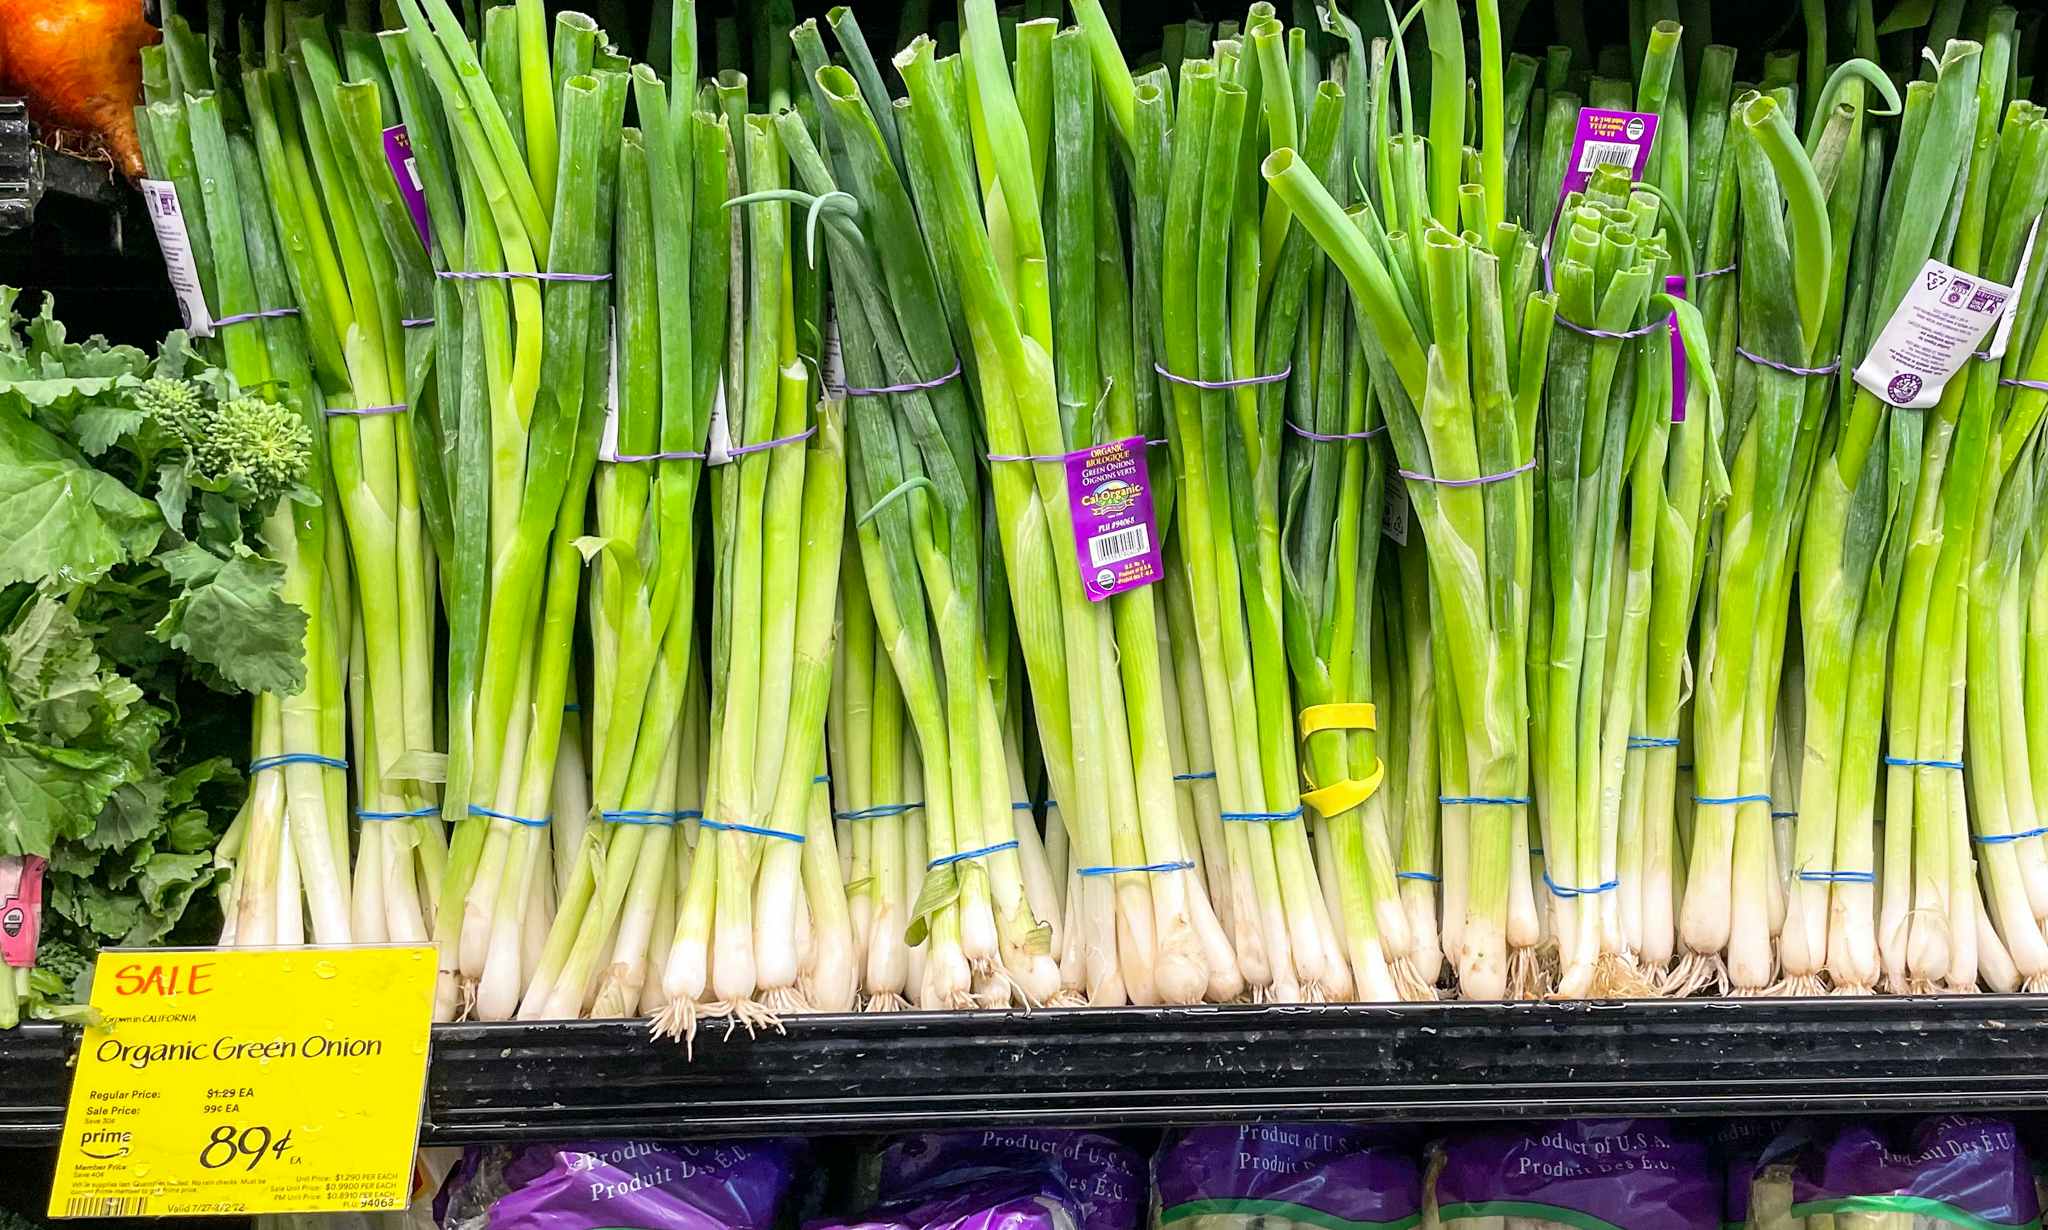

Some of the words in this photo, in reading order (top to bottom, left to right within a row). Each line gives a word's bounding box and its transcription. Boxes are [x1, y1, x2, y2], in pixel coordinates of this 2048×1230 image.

[1091, 443, 1125, 458] ORGANIC
[115, 963, 216, 996] SALE
[142, 1013, 197, 1023] CALIFORNIA
[96, 1038, 210, 1069] Organic
[213, 1035, 296, 1061] Green
[302, 1035, 382, 1058] Onion
[90, 1090, 129, 1101] Regular
[131, 1089, 161, 1099] Price:
[238, 1087, 254, 1098] EA
[86, 1106, 109, 1116] Sale
[111, 1105, 141, 1115] Price:
[225, 1103, 240, 1113] EA
[80, 1127, 132, 1148] prime
[981, 1130, 1058, 1154] Product
[1063, 1137, 1085, 1160] of
[1239, 1124, 1300, 1147] Product
[1305, 1133, 1319, 1151] of
[1595, 1136, 1612, 1154] of
[199, 1125, 294, 1172] 89¢
[289, 1156, 302, 1165] EA
[377, 1172, 398, 1181] EACH
[590, 1166, 673, 1202] Produit
